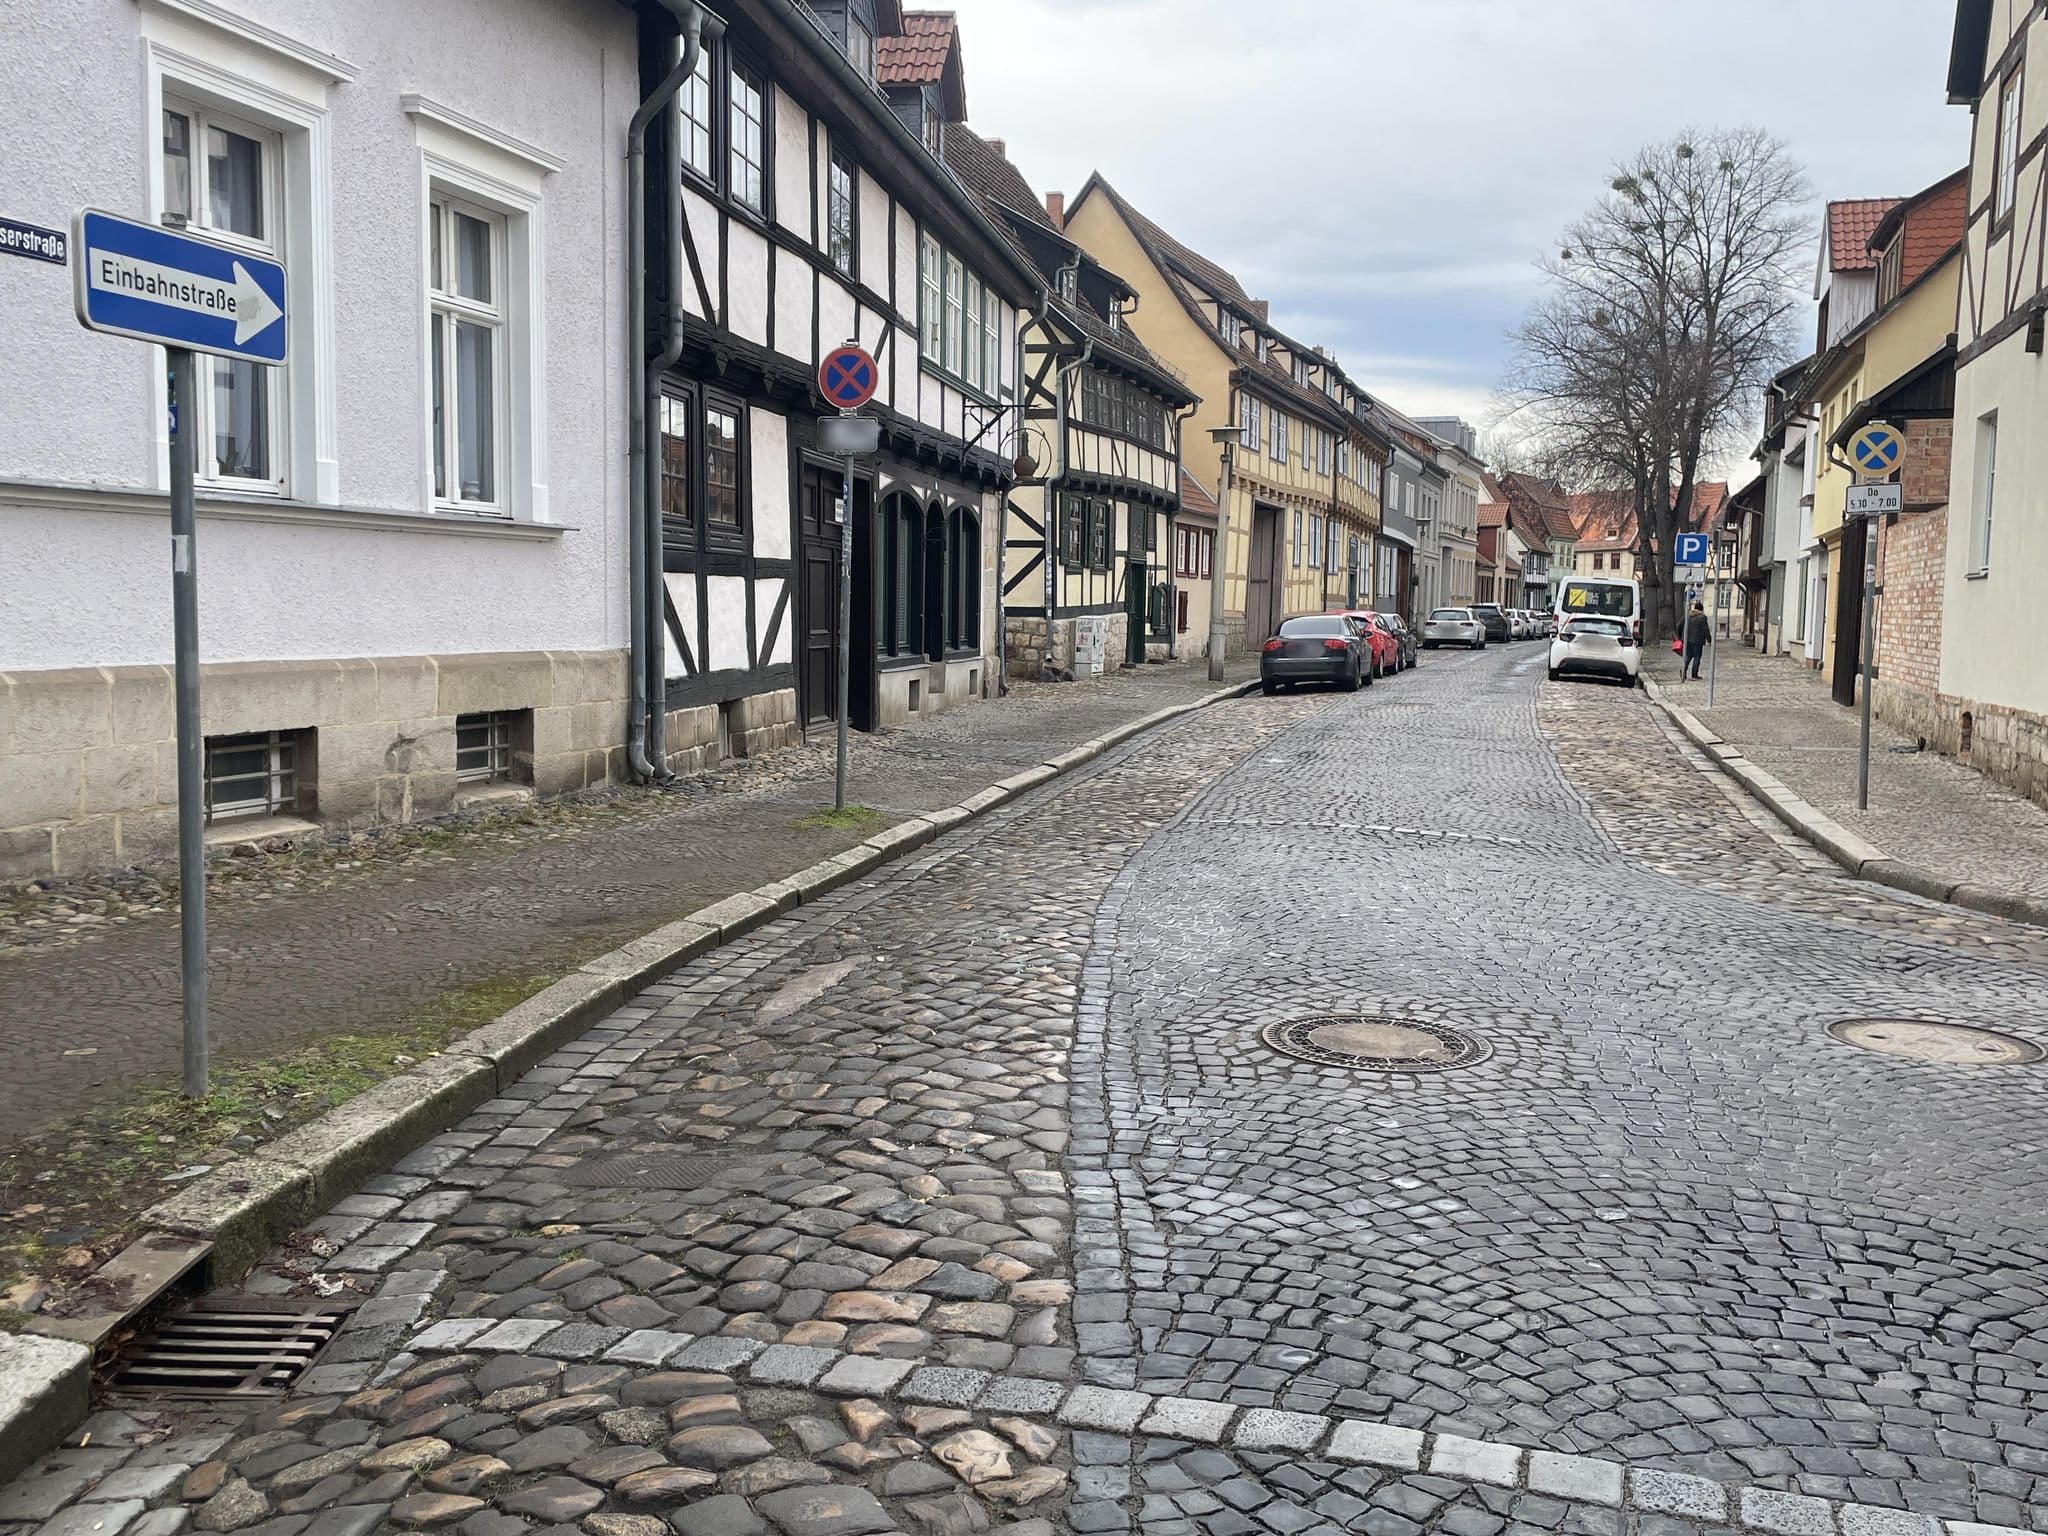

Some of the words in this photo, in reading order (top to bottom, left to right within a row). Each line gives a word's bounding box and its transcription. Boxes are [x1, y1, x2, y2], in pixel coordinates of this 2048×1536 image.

[102, 259, 237, 313] Einbahnstraße
[1867, 487, 1879, 497] Do
[1879, 497, 1897, 508] 7.00
[1682, 537, 1701, 561] P
